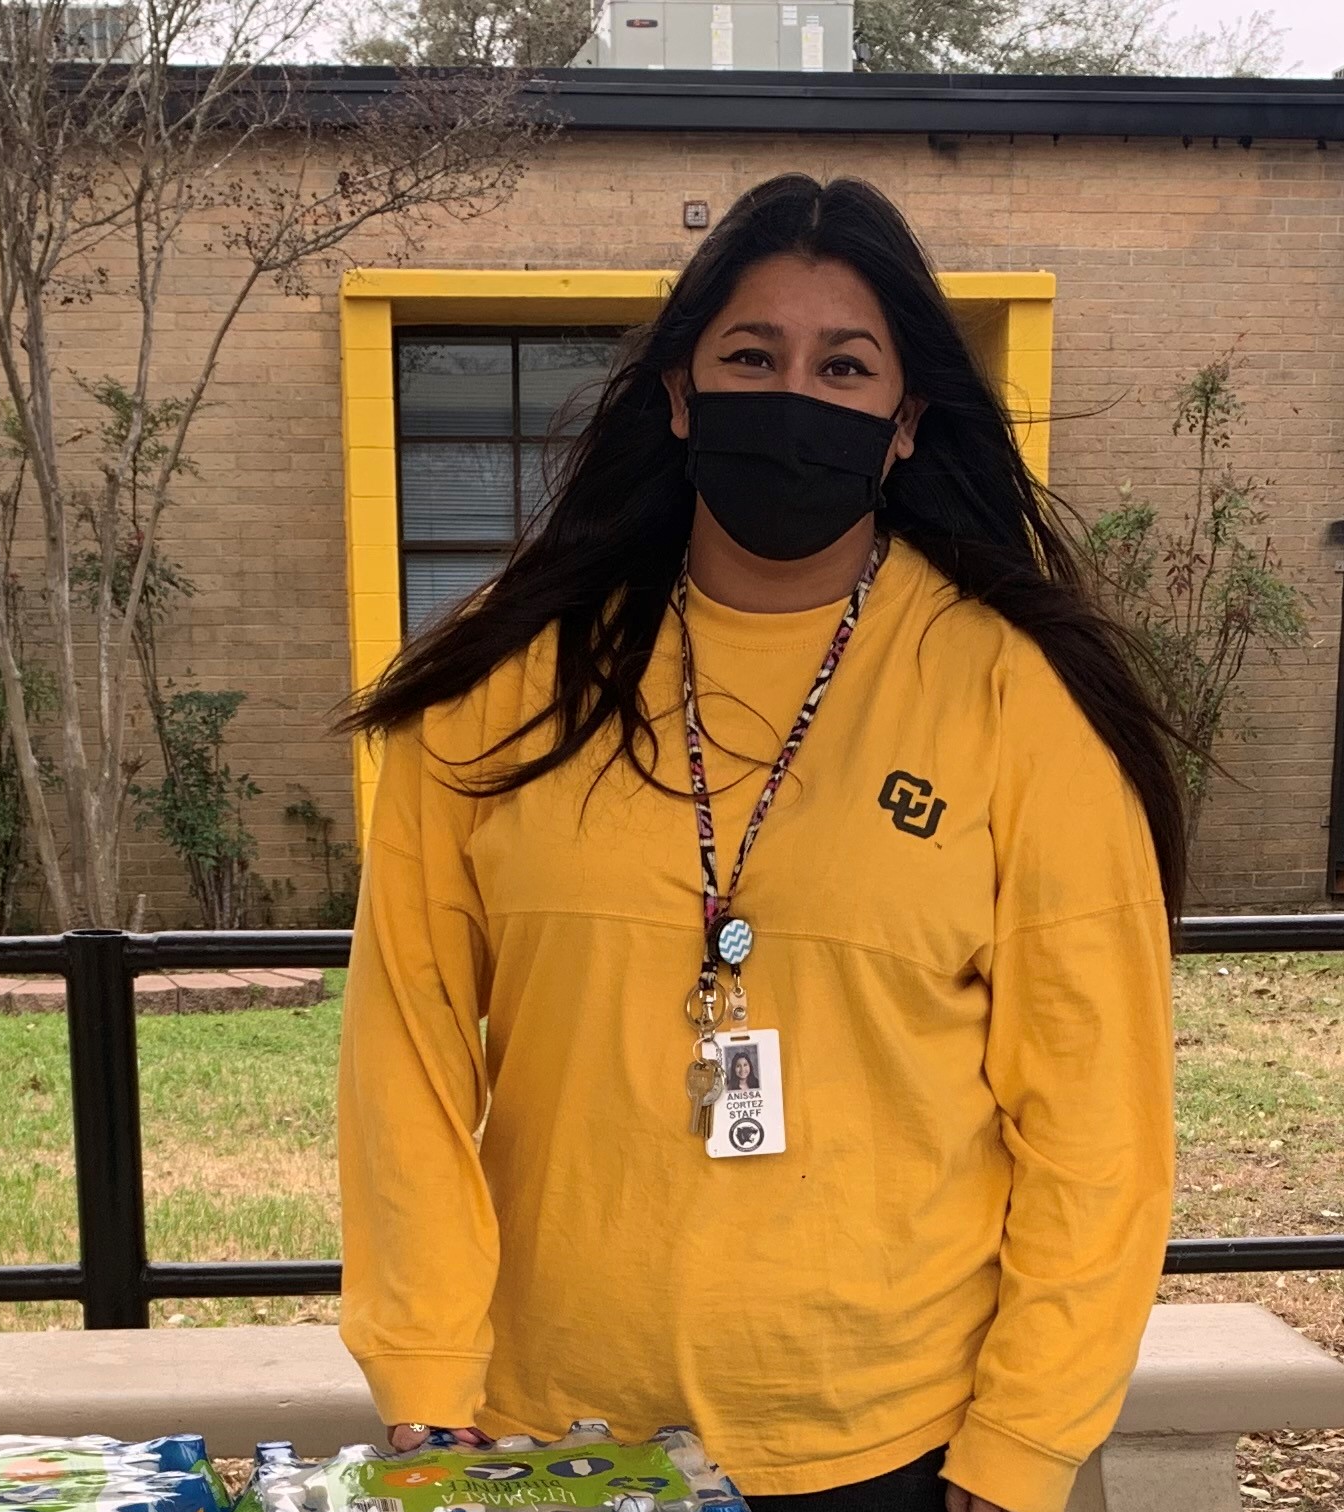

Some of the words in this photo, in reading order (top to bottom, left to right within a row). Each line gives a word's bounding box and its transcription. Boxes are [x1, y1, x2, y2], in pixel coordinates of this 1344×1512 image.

[878, 770, 947, 839] CU
[727, 1091, 761, 1100] ANISSA
[727, 1100, 763, 1110] CORTEZ
[730, 1109, 761, 1119] STAFF
